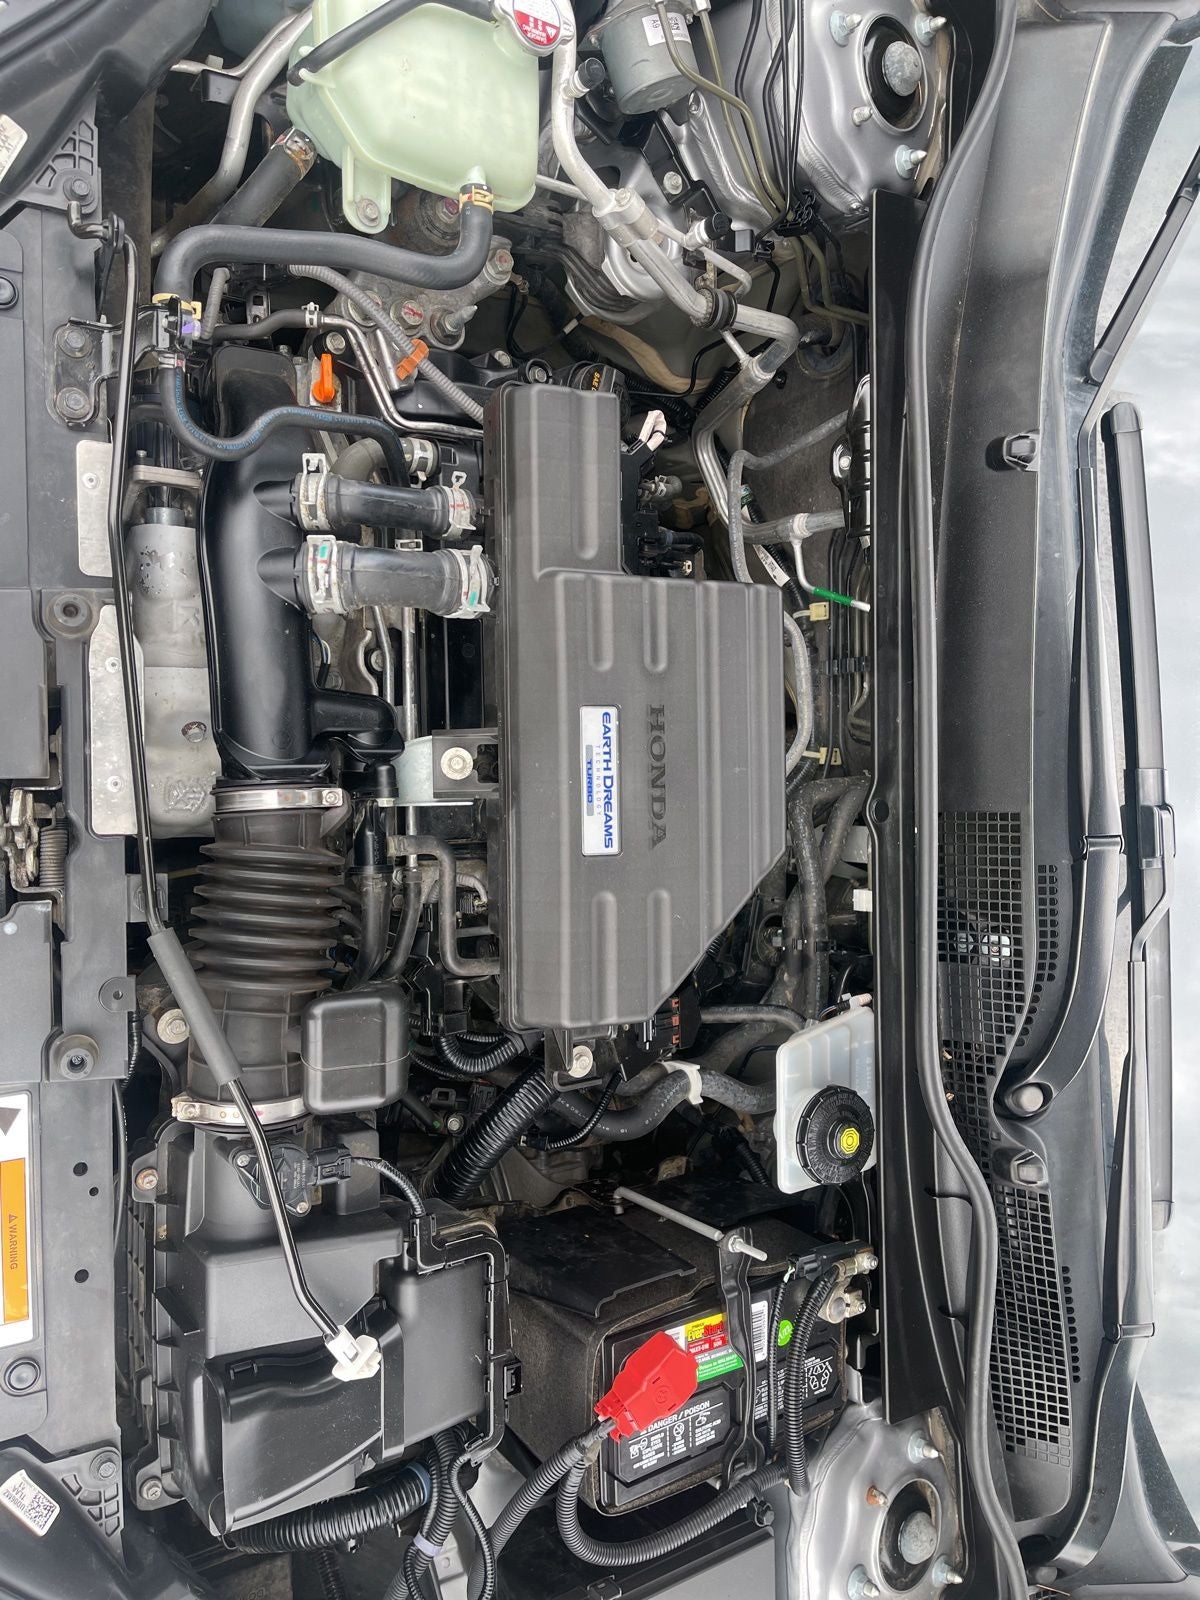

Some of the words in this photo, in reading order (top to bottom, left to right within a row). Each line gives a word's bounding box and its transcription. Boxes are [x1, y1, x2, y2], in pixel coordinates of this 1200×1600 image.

[592, 371, 601, 388] SAE
[602, 711, 613, 772] EARTH
[586, 759, 594, 803] TURBO
[649, 704, 667, 848] HONDA
[603, 775, 614, 849] DREAMS
[8, 1224, 19, 1270] WARNING
[647, 1415, 678, 1432] DANGER
[684, 1400, 710, 1418] POISON
